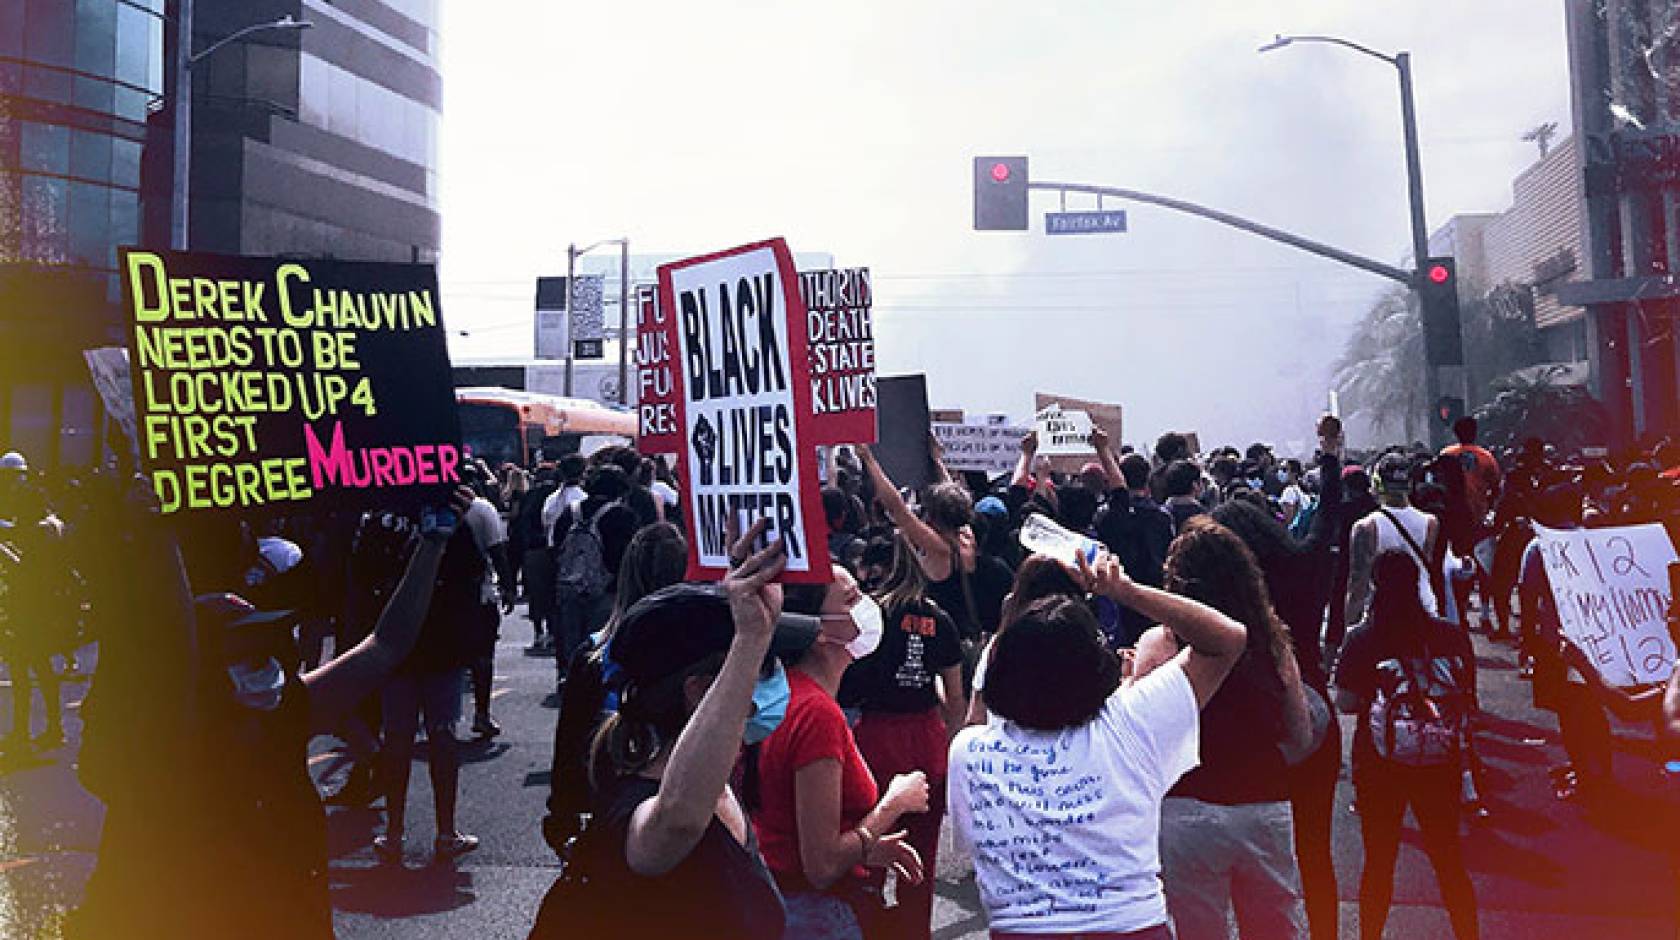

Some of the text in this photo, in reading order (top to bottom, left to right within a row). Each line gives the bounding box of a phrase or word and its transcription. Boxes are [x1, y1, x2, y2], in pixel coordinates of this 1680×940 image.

[127, 251, 437, 331] DEREK CHAUVIN
[136, 325, 361, 372] NEEDS TO BE
[680, 272, 787, 402] BLACK
[808, 308, 873, 341] DEATH
[143, 370, 378, 420] LOCKED UP 4
[827, 371, 878, 413] LIVES
[144, 415, 258, 459] FIRST
[717, 404, 793, 486] LIVES
[153, 420, 461, 513] DEGREE MURDER
